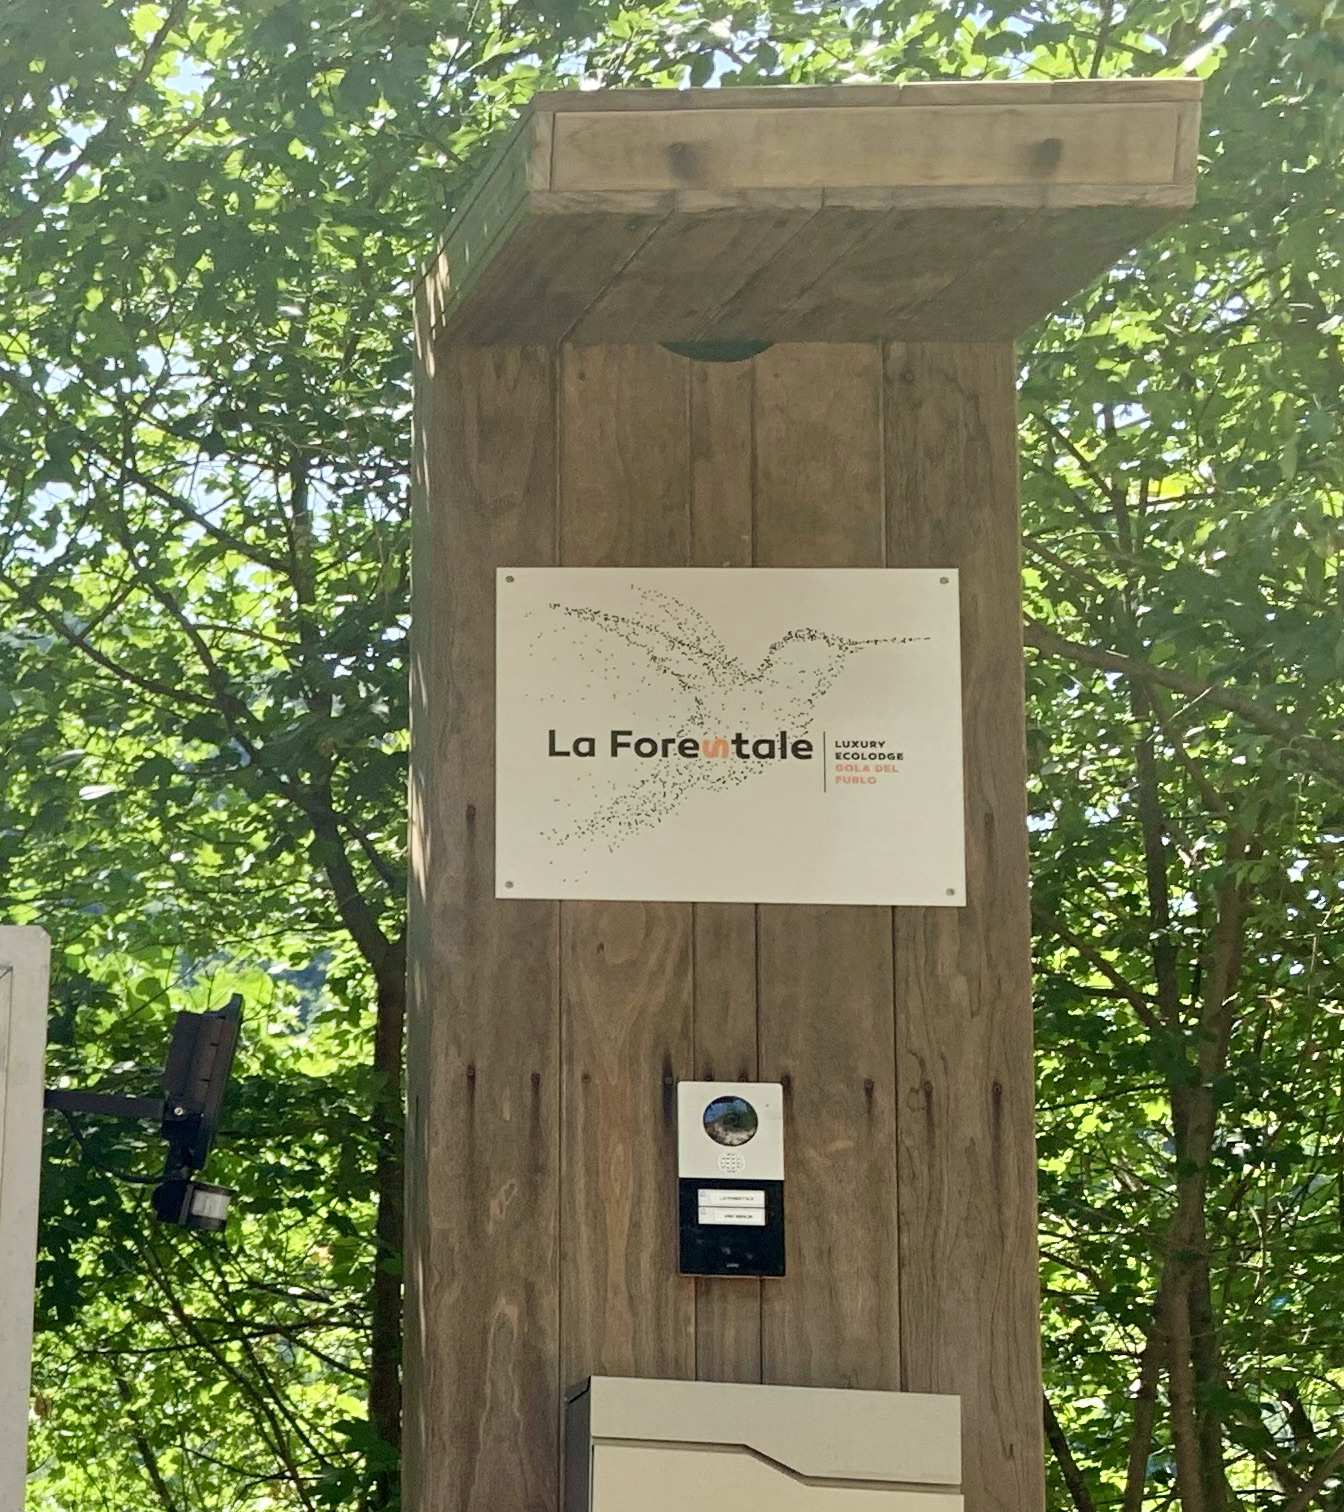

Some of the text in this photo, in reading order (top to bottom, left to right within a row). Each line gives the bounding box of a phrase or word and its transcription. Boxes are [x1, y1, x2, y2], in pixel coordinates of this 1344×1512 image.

[548, 729, 596, 758] La
[834, 740, 886, 749] LUXURY
[834, 752, 904, 761] ECOLODGE
[835, 764, 899, 773] GOLA DEL
[835, 776, 877, 784] FURLO
